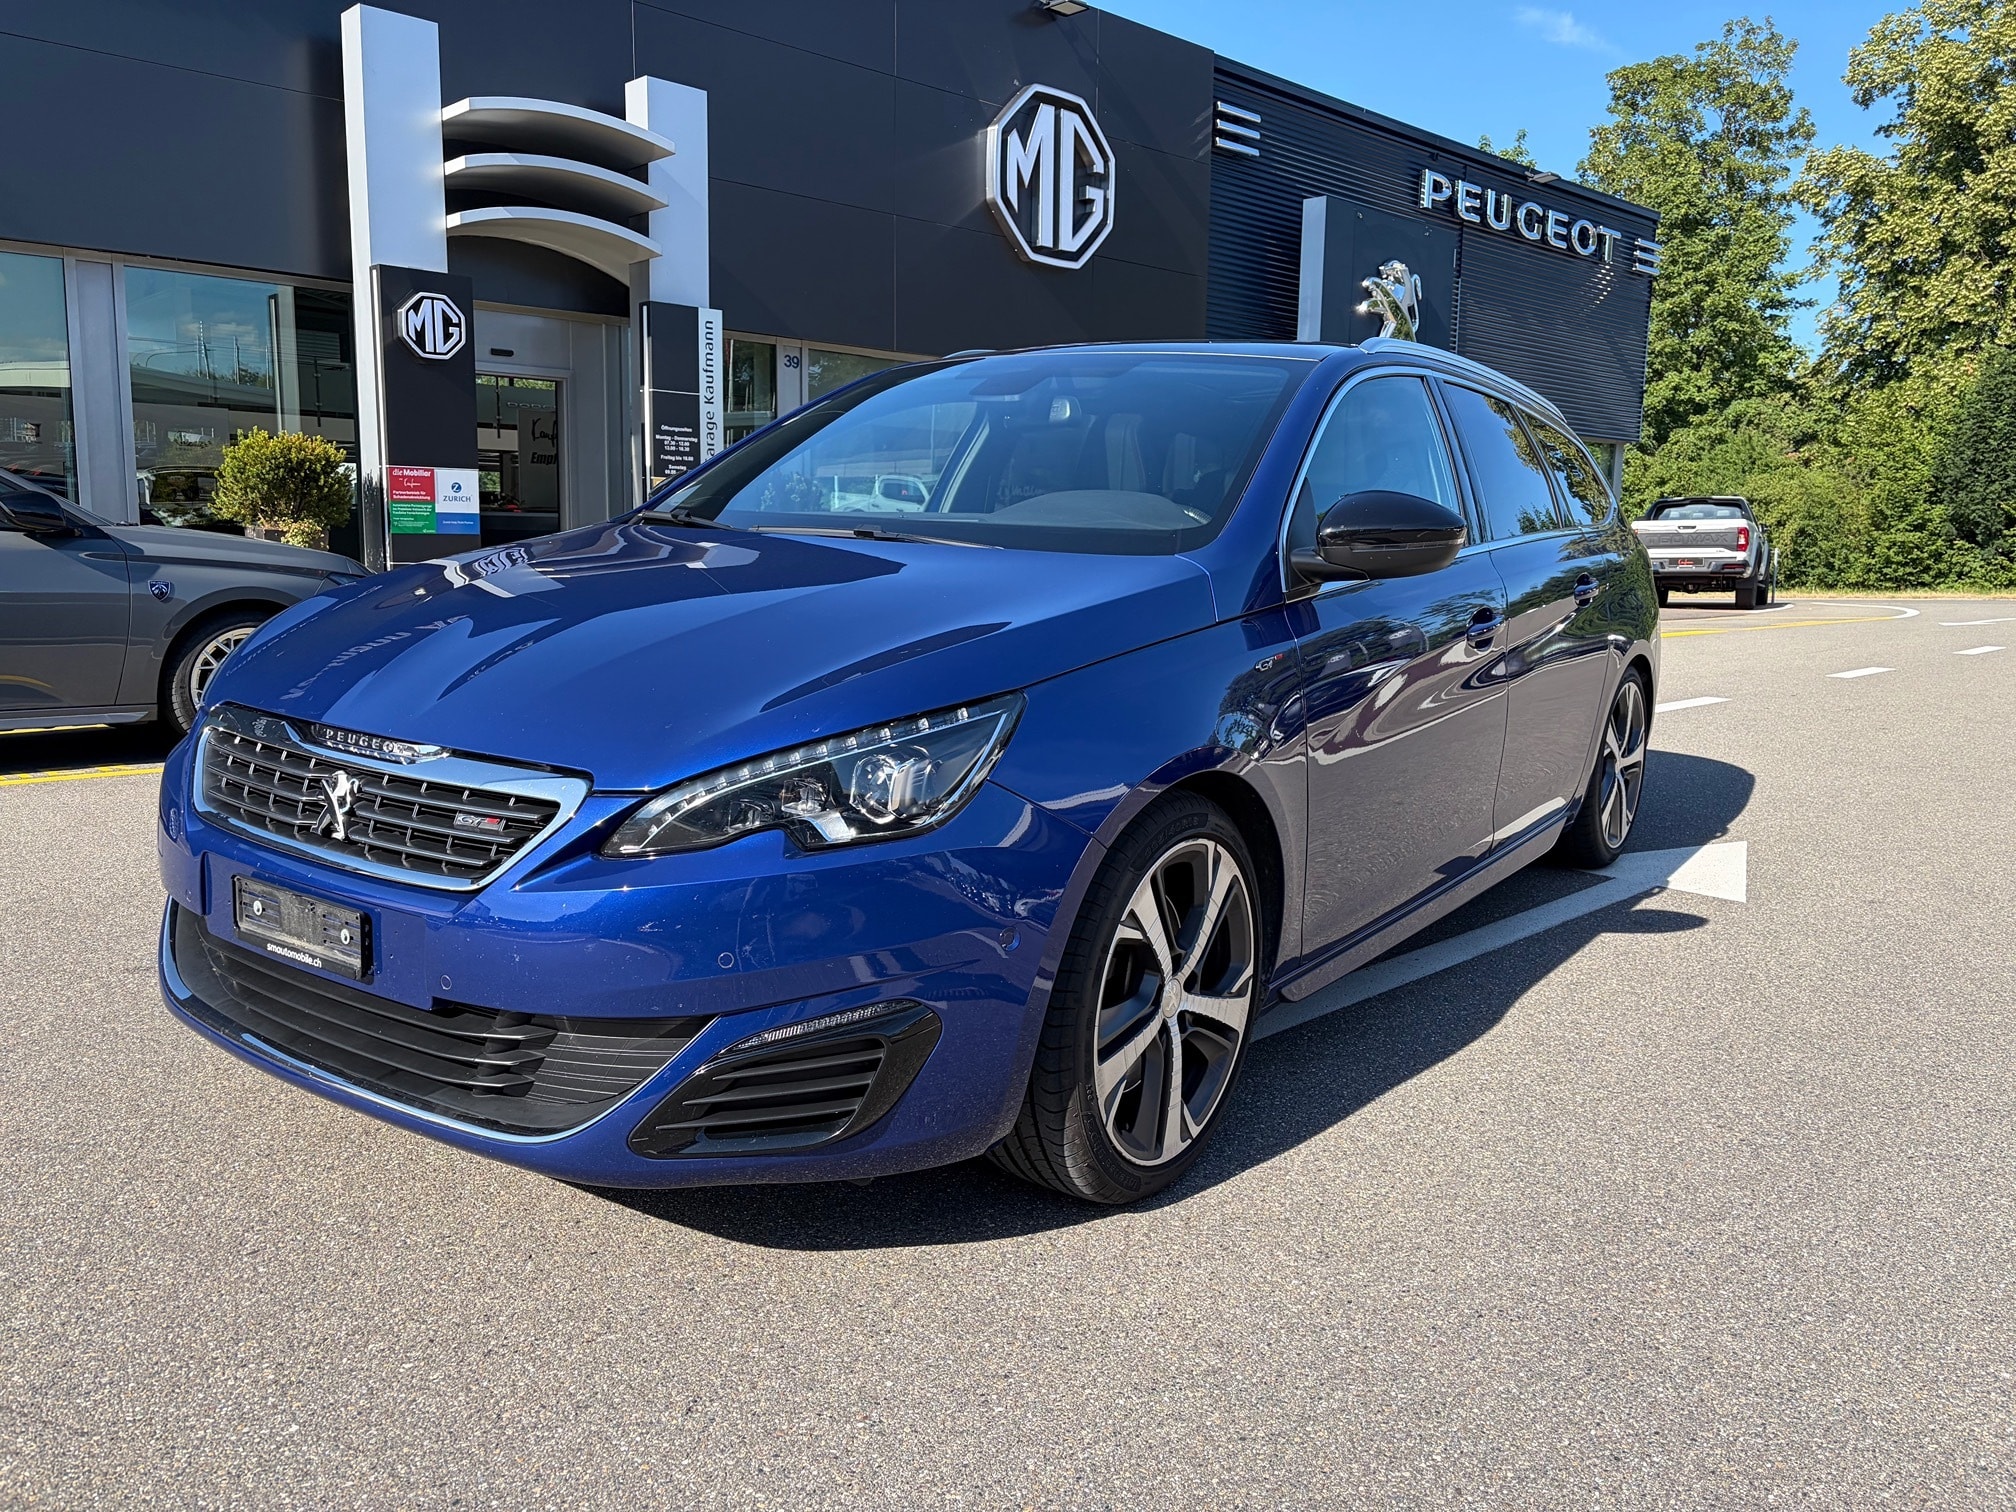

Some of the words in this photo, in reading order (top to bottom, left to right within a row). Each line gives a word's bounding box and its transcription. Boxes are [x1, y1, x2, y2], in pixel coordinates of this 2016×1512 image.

[1006, 102, 1105, 253] MG
[1419, 168, 1623, 264] PEUGEOT
[408, 298, 460, 354] MG
[703, 320, 714, 404] Kaufmann
[783, 354, 800, 369] 39
[704, 411, 718, 461] arage
[403, 469, 431, 477] Mobiliar
[266, 942, 322, 968] smautomobile.ch
